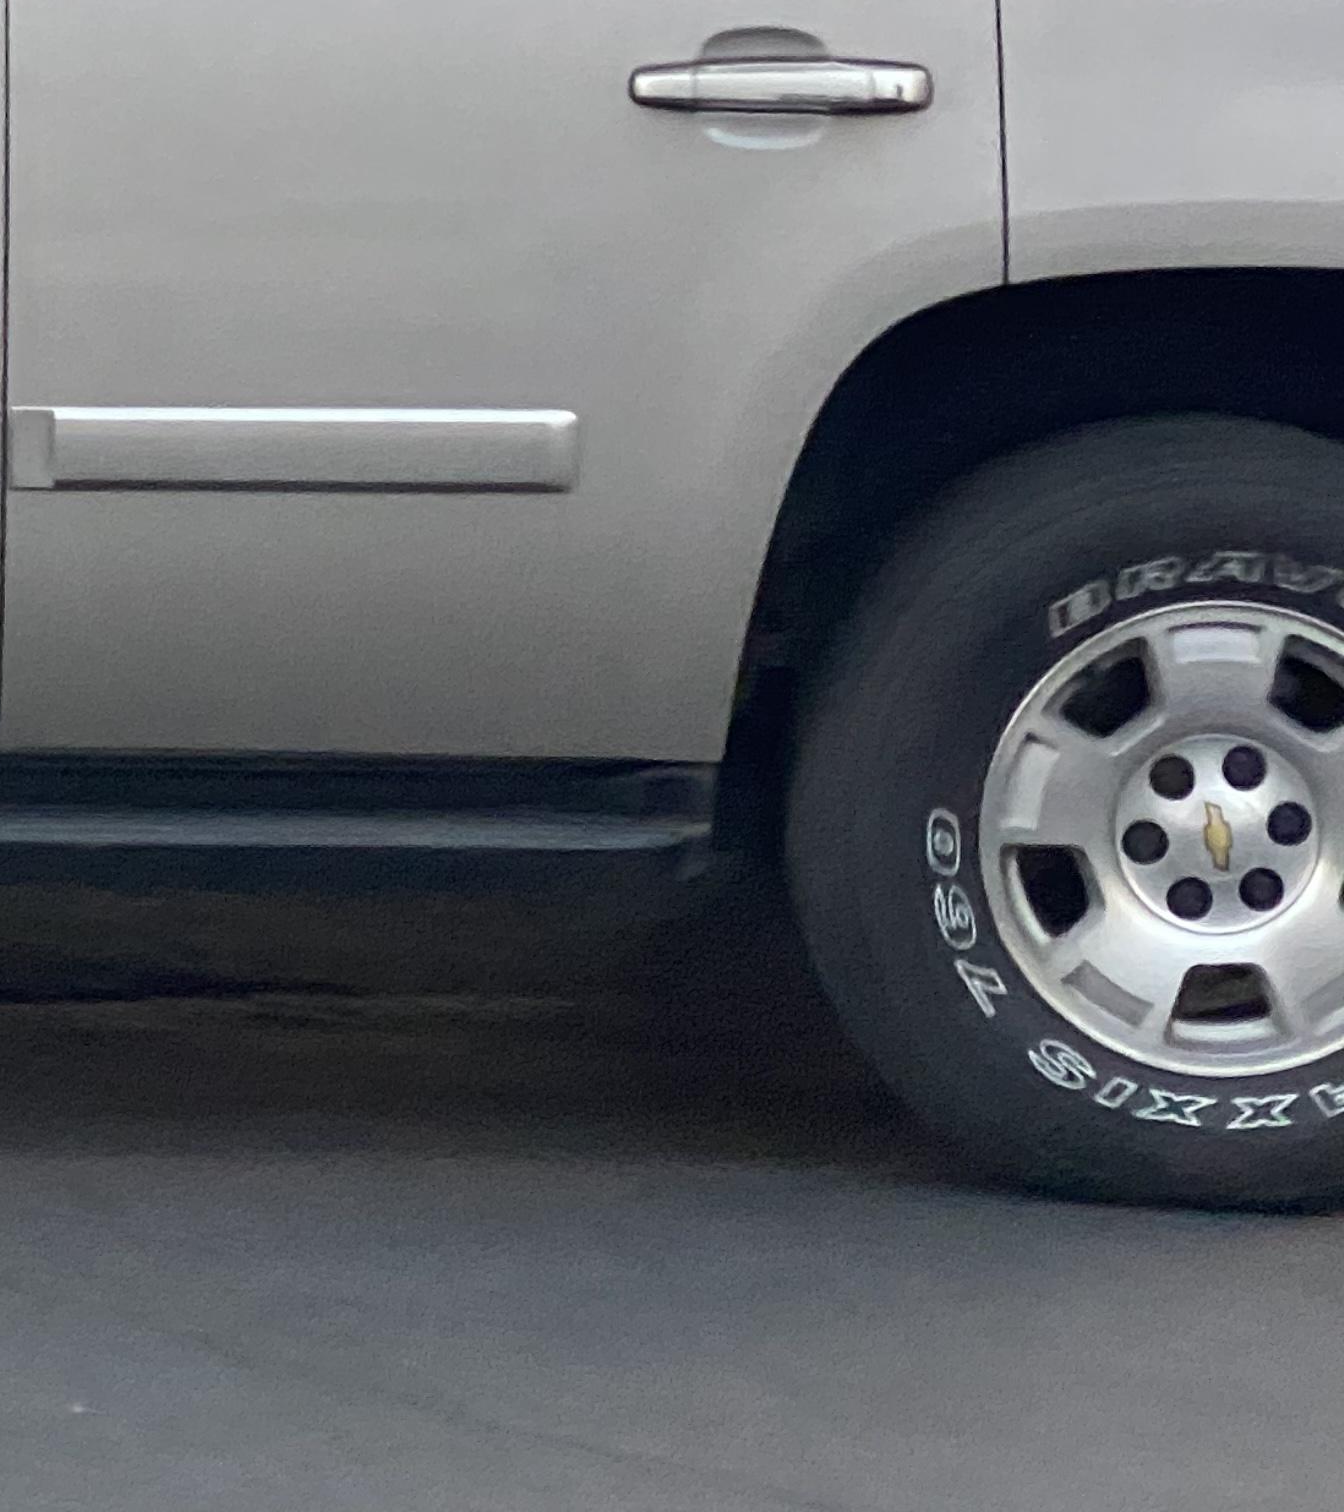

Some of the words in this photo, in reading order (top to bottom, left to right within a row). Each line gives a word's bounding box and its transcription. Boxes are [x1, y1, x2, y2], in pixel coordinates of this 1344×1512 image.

[1047, 549, 1344, 640] BRAV
[925, 807, 1008, 1019] 760
[1027, 1039, 1344, 1130] XXIS
